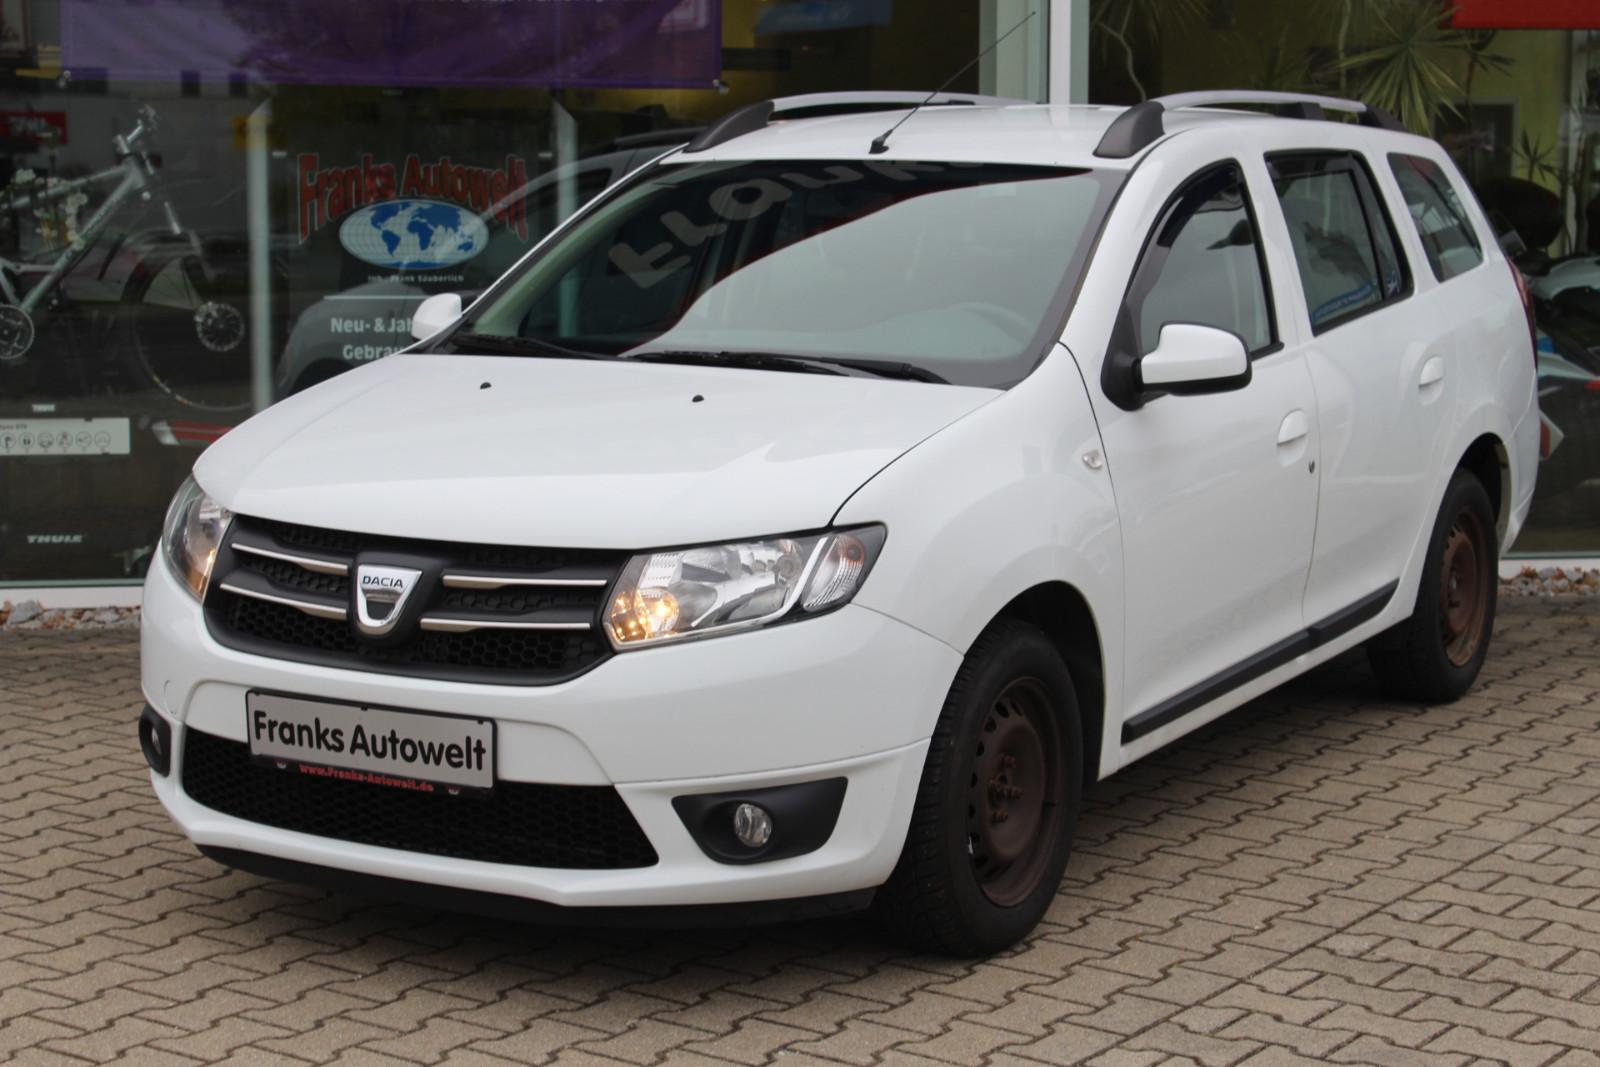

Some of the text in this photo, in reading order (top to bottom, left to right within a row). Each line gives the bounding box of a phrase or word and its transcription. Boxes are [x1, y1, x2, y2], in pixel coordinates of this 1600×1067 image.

[297, 152, 529, 245] Franks Autowelt
[330, 317, 371, 333] Neu-
[374, 317, 385, 333] &
[27, 534, 83, 544] THULE
[362, 575, 404, 589] DACIA
[253, 710, 487, 771] Franks Autowelt
